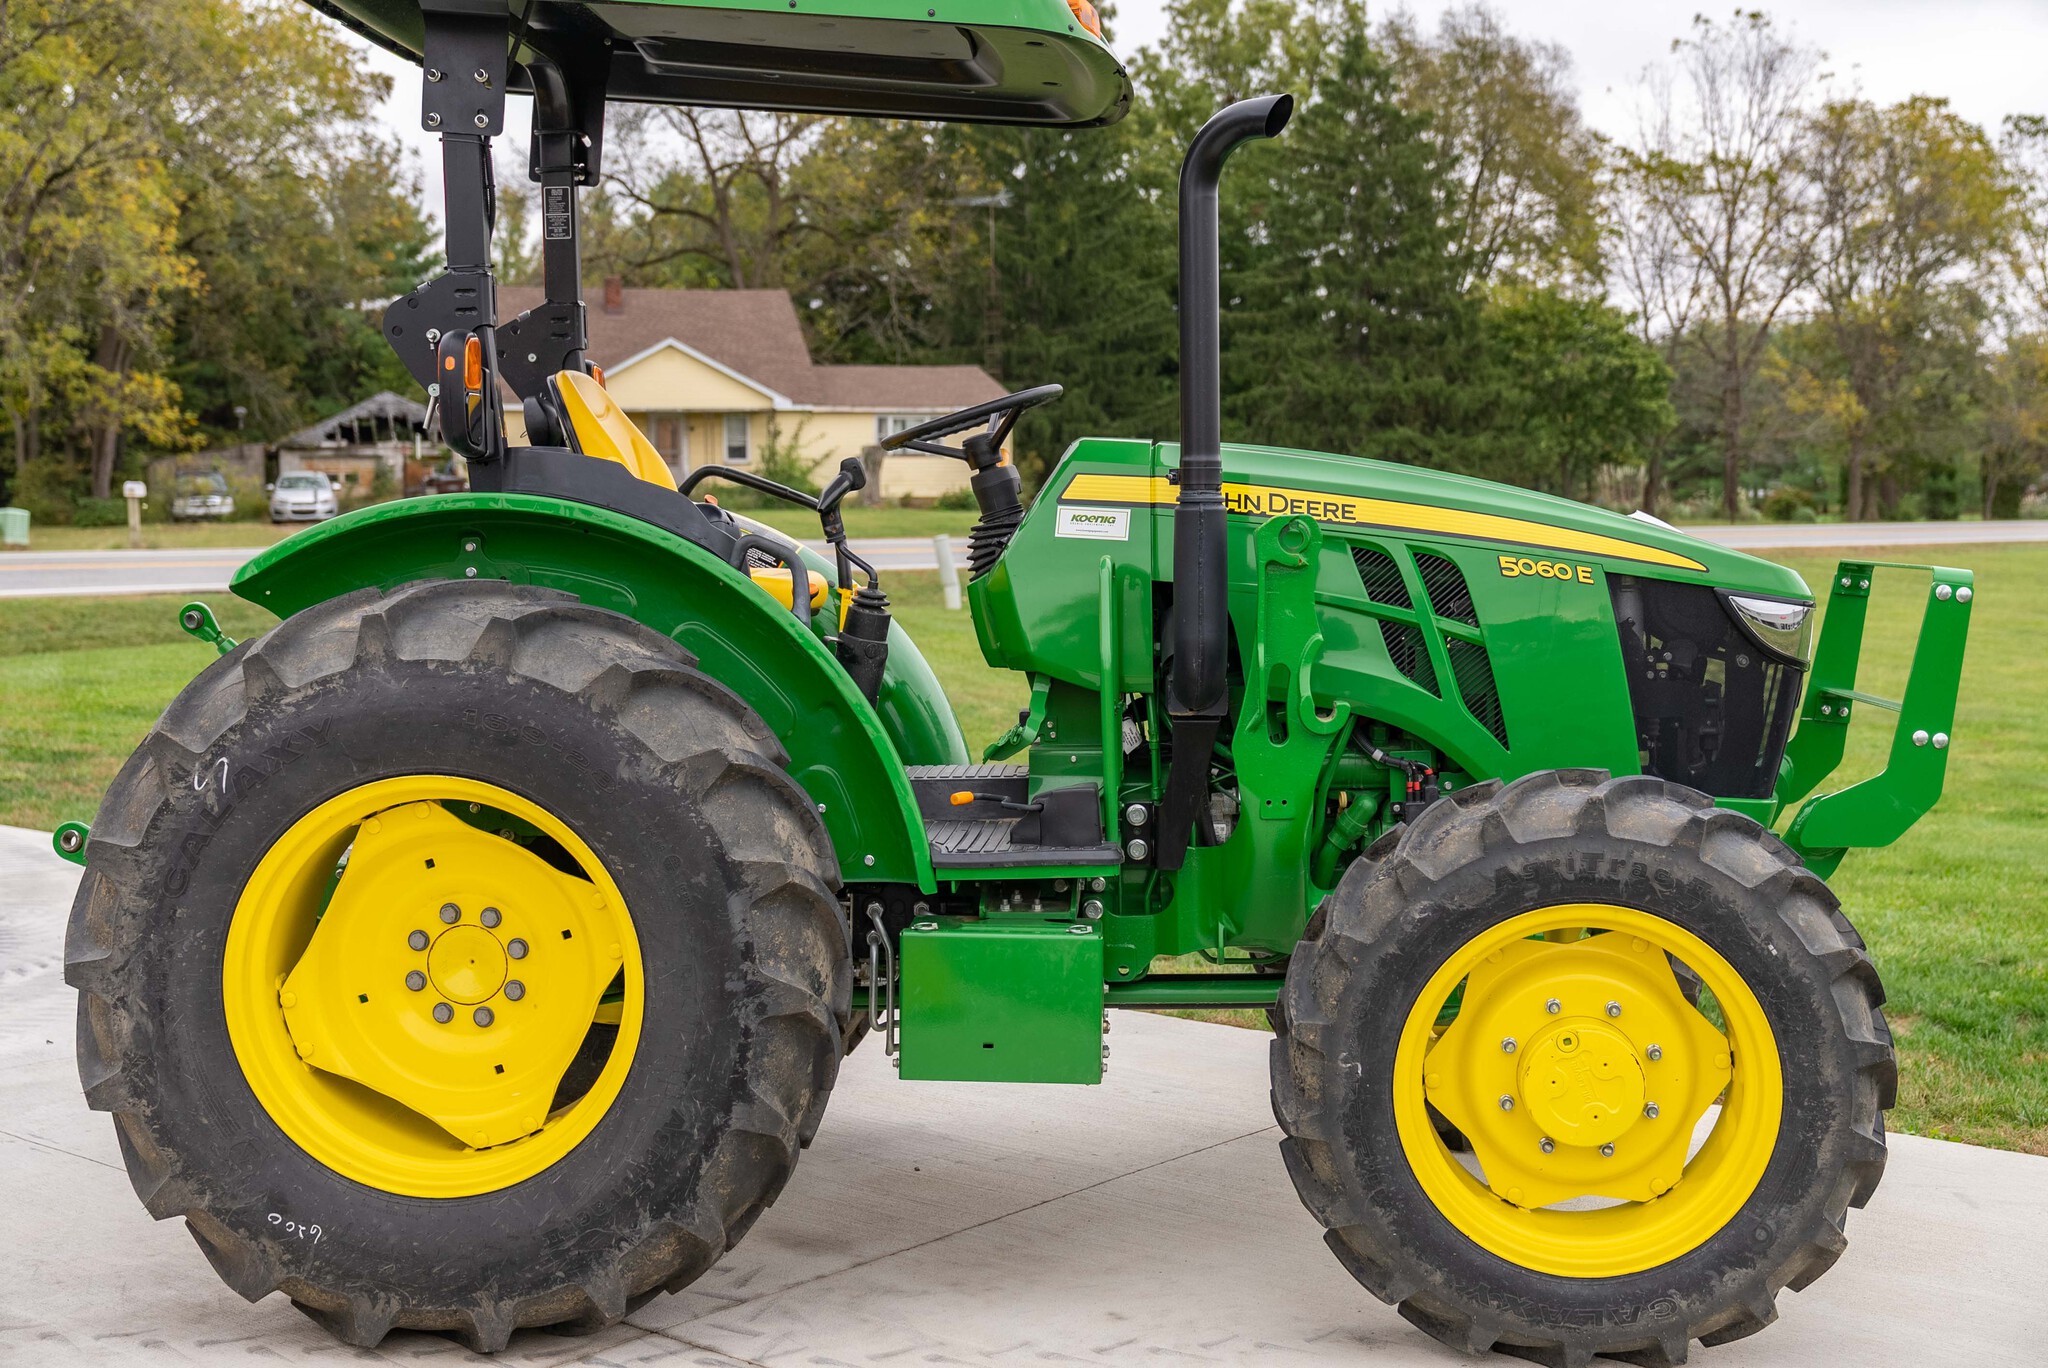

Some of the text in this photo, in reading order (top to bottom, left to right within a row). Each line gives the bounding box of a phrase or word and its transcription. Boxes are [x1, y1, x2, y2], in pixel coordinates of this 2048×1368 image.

[1225, 492, 1357, 521] HN DEERE
[1498, 555, 1595, 585] 5060 E
[162, 715, 334, 898] GALAXY
[1463, 1282, 1679, 1328] GALAXY
